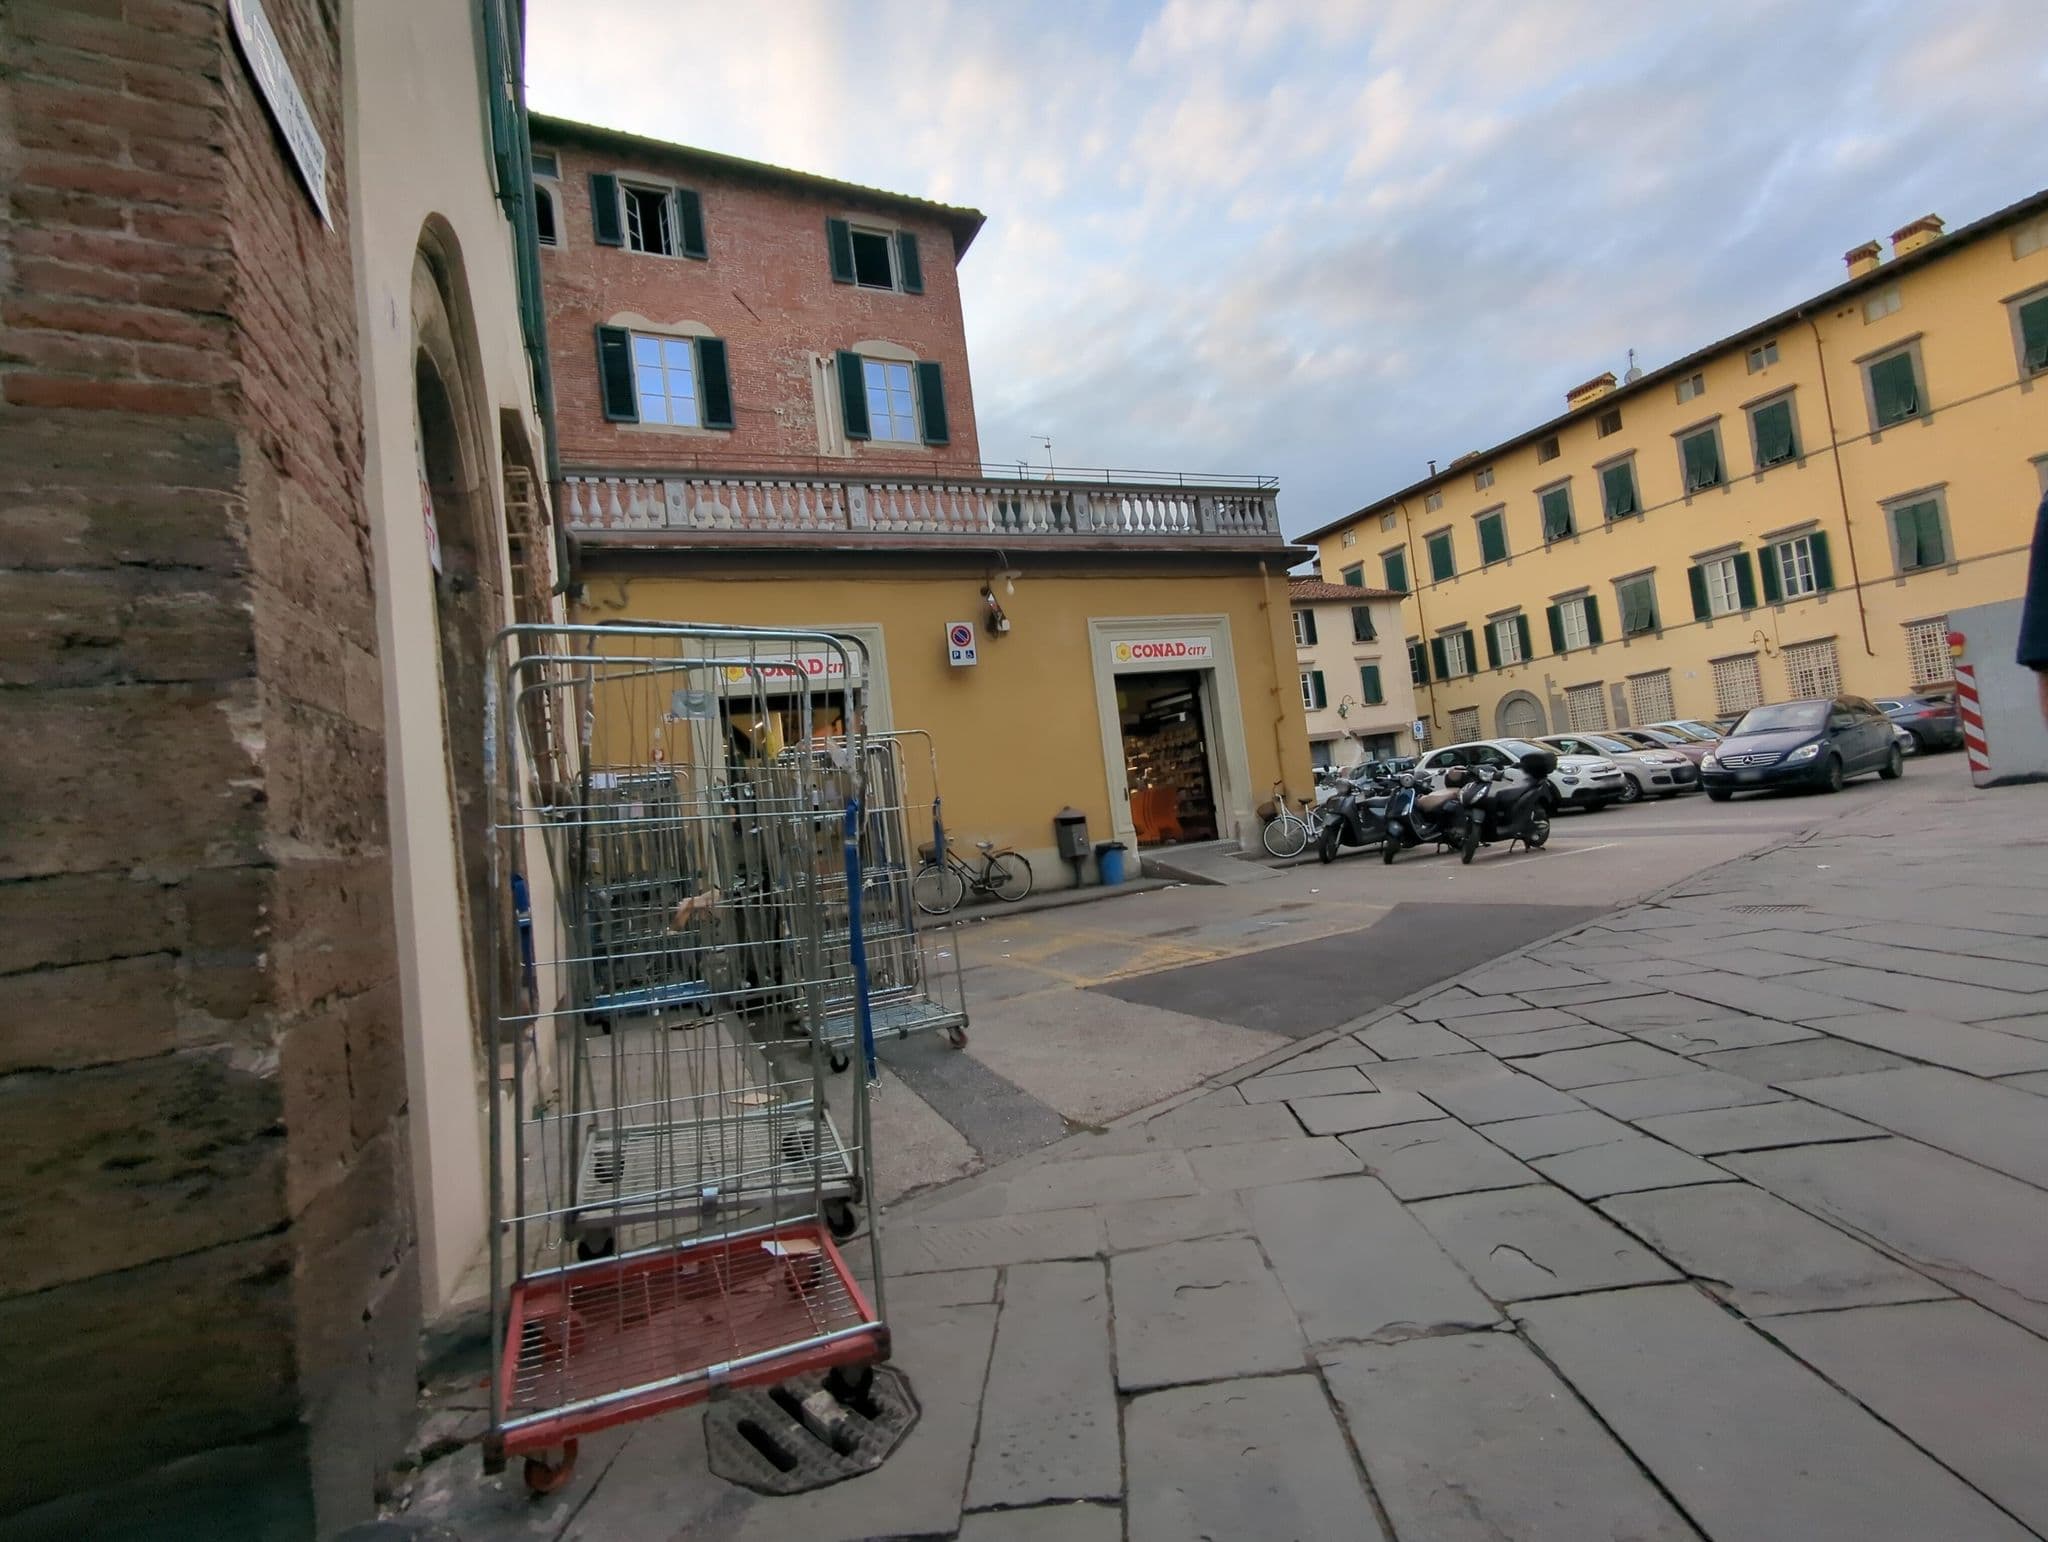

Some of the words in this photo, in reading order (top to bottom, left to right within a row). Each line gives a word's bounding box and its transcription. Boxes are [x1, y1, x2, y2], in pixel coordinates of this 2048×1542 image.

[1132, 642, 1186, 658] CONAD
[1187, 646, 1207, 656] CITY
[827, 662, 847, 674] CIT
